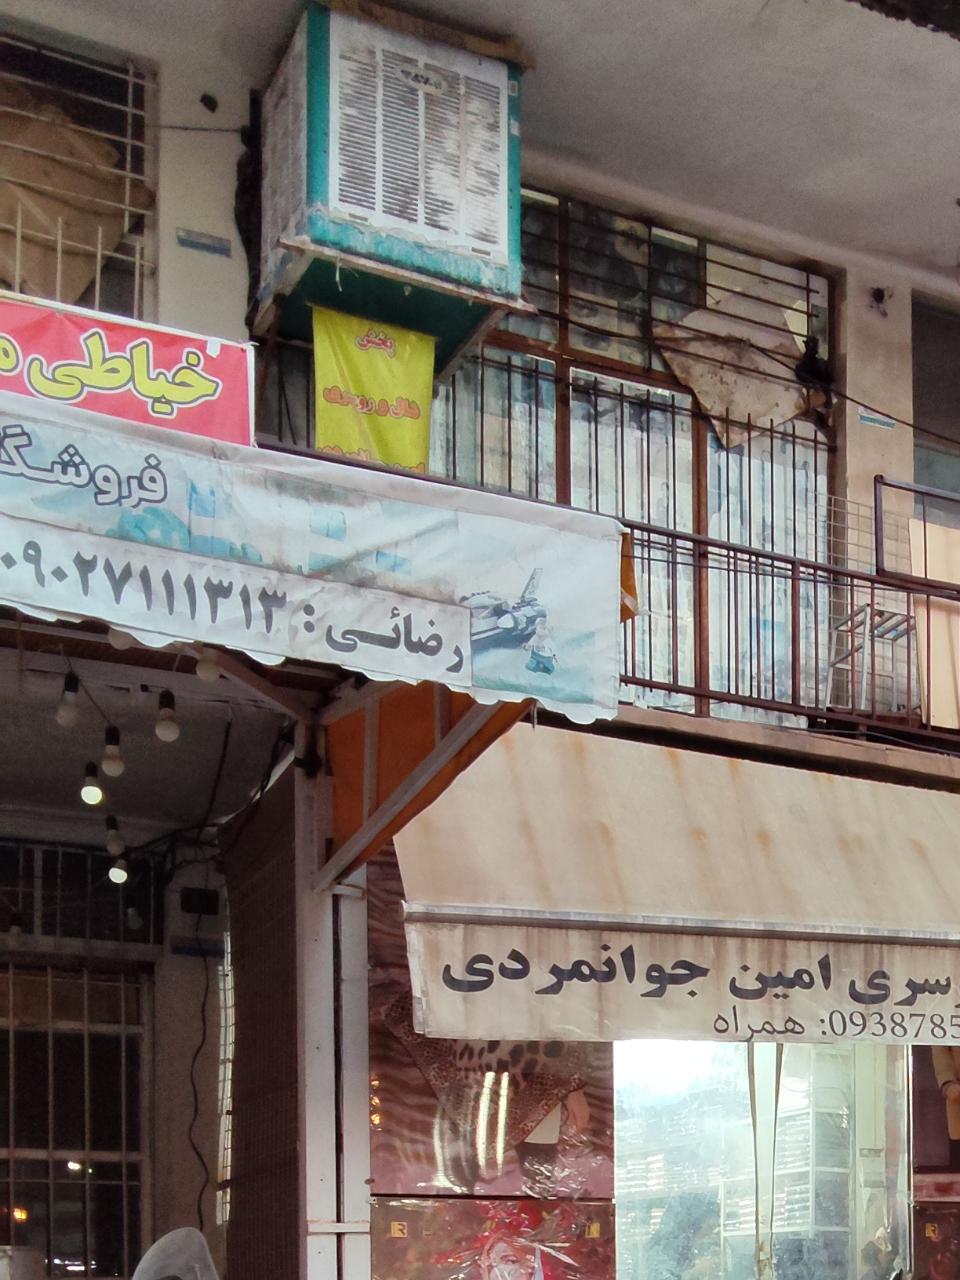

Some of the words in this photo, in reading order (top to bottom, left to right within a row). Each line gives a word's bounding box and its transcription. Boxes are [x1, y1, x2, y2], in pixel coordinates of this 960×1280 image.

[27, 328, 222, 418] خیاطی
[0, 424, 167, 508] فروشگ
[0, 540, 287, 634] ۰۹۰۲۷۱۱۱۳۱۳
[442, 944, 711, 998] جوانمردی
[728, 953, 832, 1001] امین
